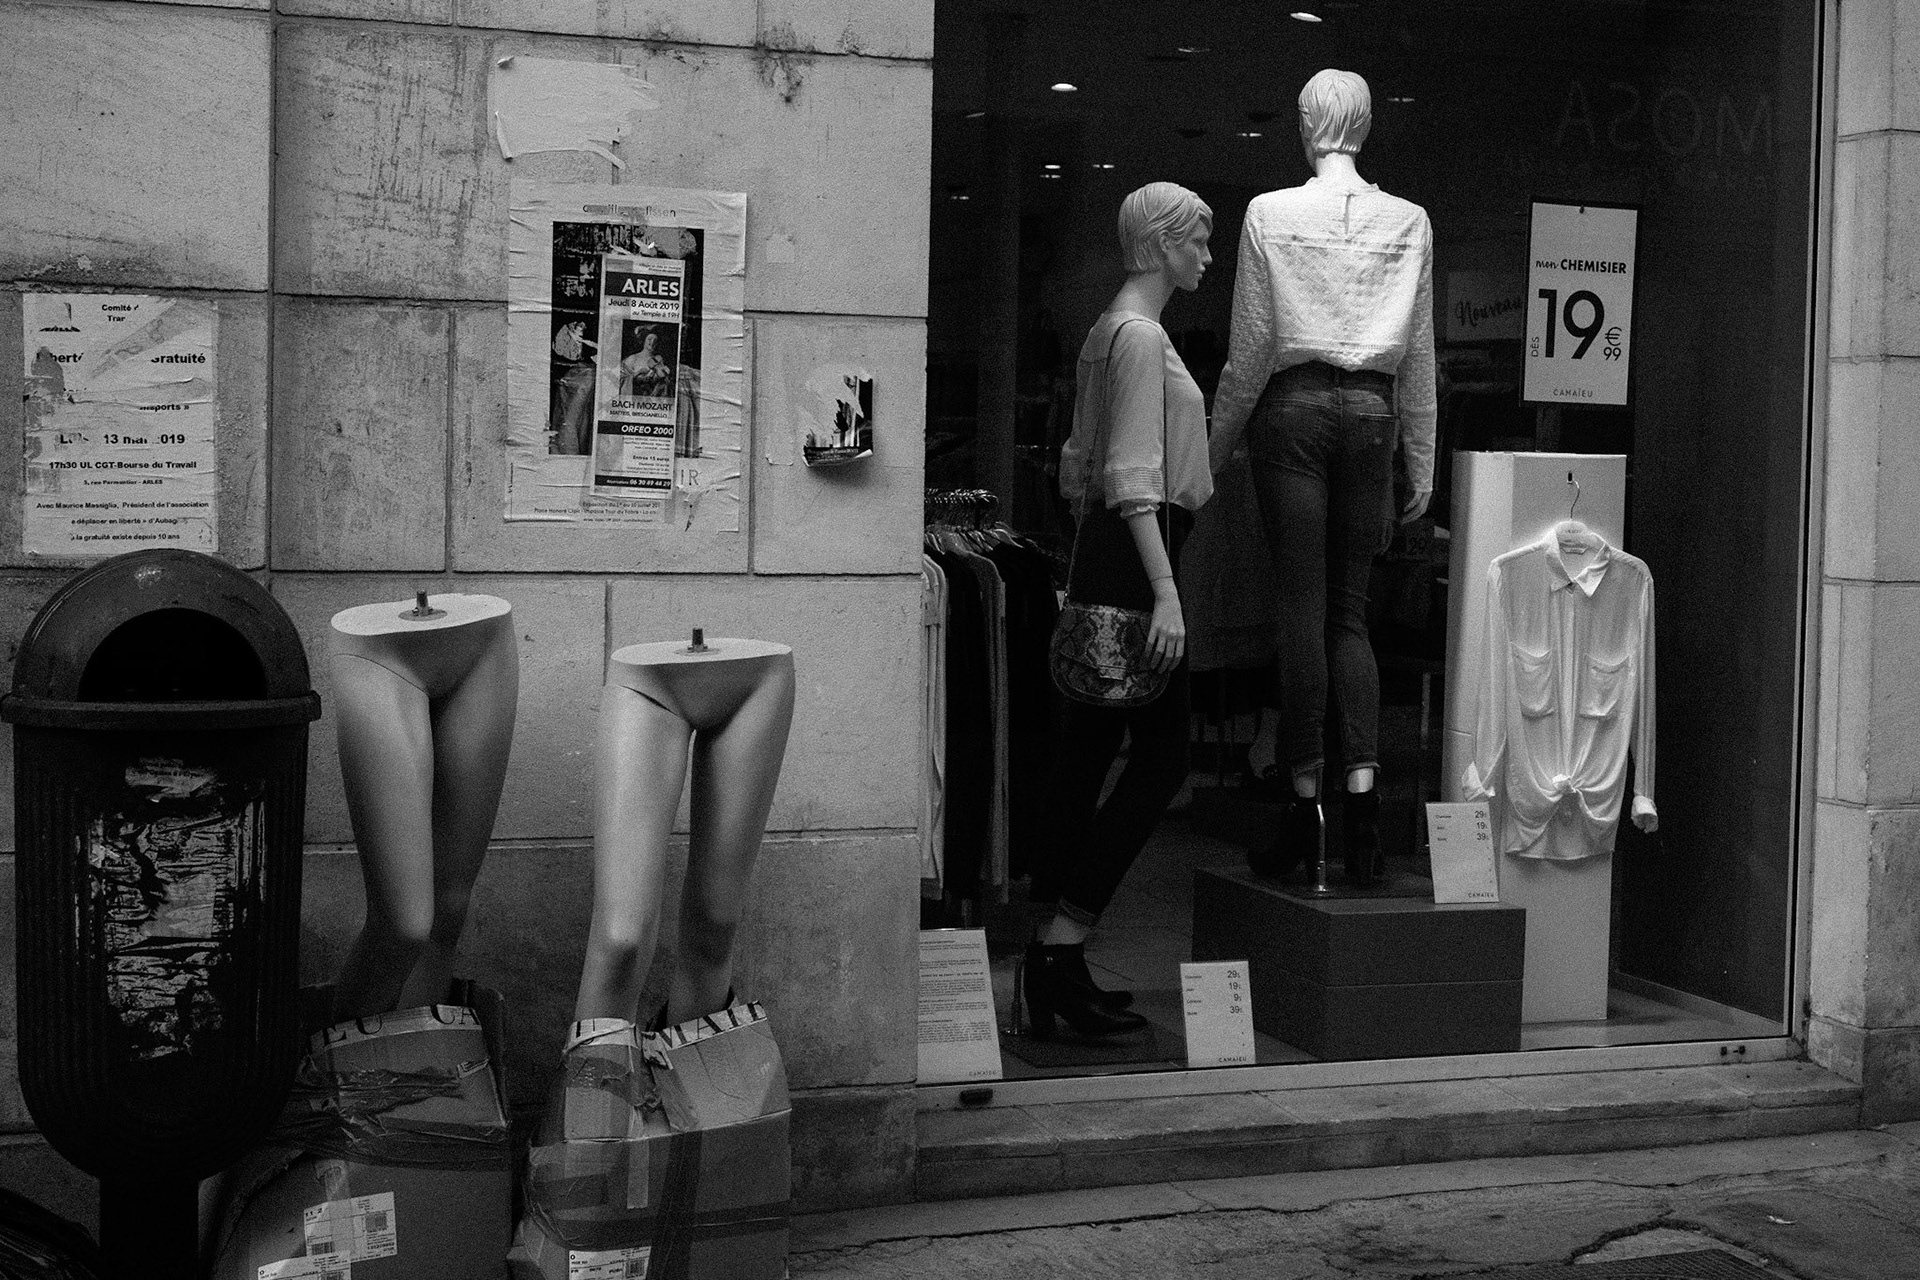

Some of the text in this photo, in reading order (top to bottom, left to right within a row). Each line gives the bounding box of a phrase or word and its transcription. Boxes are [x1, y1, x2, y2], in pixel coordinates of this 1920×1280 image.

[1535, 258, 1627, 274] mon CHEMISIER
[621, 278, 680, 297] ARLES
[101, 303, 132, 312] Comité
[607, 298, 680, 311] Jeudi 8 Août 2019
[641, 309, 662, 318] Temple
[1538, 288, 1605, 360] 19
[1604, 326, 1623, 347] €
[1603, 346, 1622, 361] 99
[611, 400, 673, 411] BACH MOZART
[621, 424, 674, 436] ORFEO 2000
[103, 434, 119, 444] 13
[153, 434, 185, 444] 019
[49, 461, 197, 469] 17h30 UL CGT-Bourse du Travail
[76, 517, 107, 526] déplacer
[118, 517, 142, 525] liberté
[84, 533, 111, 541] gratuité
[112, 533, 132, 541] existe
[133, 533, 157, 542] depuis
[1474, 810, 1485, 819] 29
[1476, 821, 1486, 830] 19
[1476, 832, 1486, 841] 39
[1227, 970, 1238, 979] 29
[1228, 981, 1239, 990] 19
[1233, 993, 1239, 1002] 9
[1229, 1005, 1240, 1014] 39
